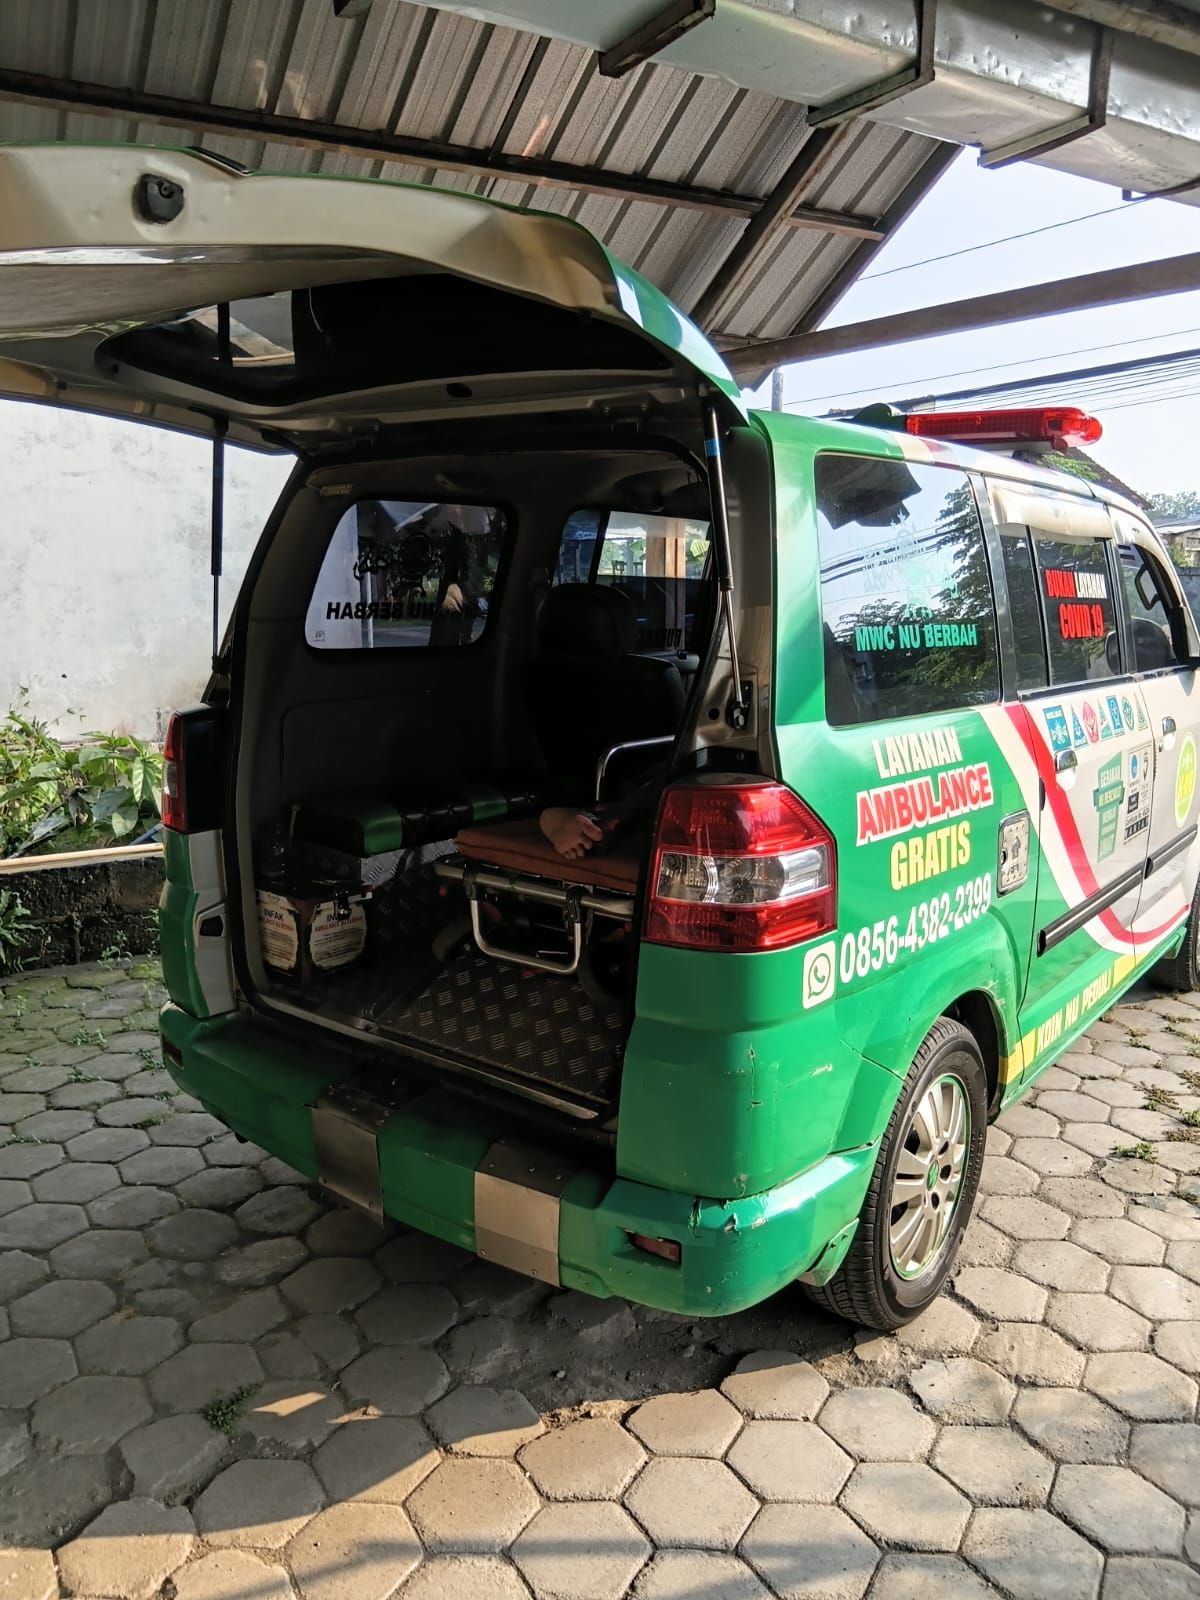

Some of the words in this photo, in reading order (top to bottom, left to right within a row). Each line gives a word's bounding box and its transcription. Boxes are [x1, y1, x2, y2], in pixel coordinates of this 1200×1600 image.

[1045, 569, 1076, 598] BUKAN
[1074, 571, 1107, 599] LAYANAN
[856, 626, 895, 651] MWC
[899, 625, 921, 649] NU
[924, 624, 978, 647] BERBAH
[1059, 603, 1092, 639] COVID
[1091, 603, 1104, 637] 19
[872, 726, 962, 779] LAYANAN
[858, 764, 992, 842] AMBULANCE
[890, 821, 971, 891] GRATIS
[840, 872, 992, 984] 0856-4382-2399
[1036, 1008, 1063, 1056] KOIN
[1064, 994, 1080, 1031] NU
[1081, 967, 1112, 1016] PEDULI
